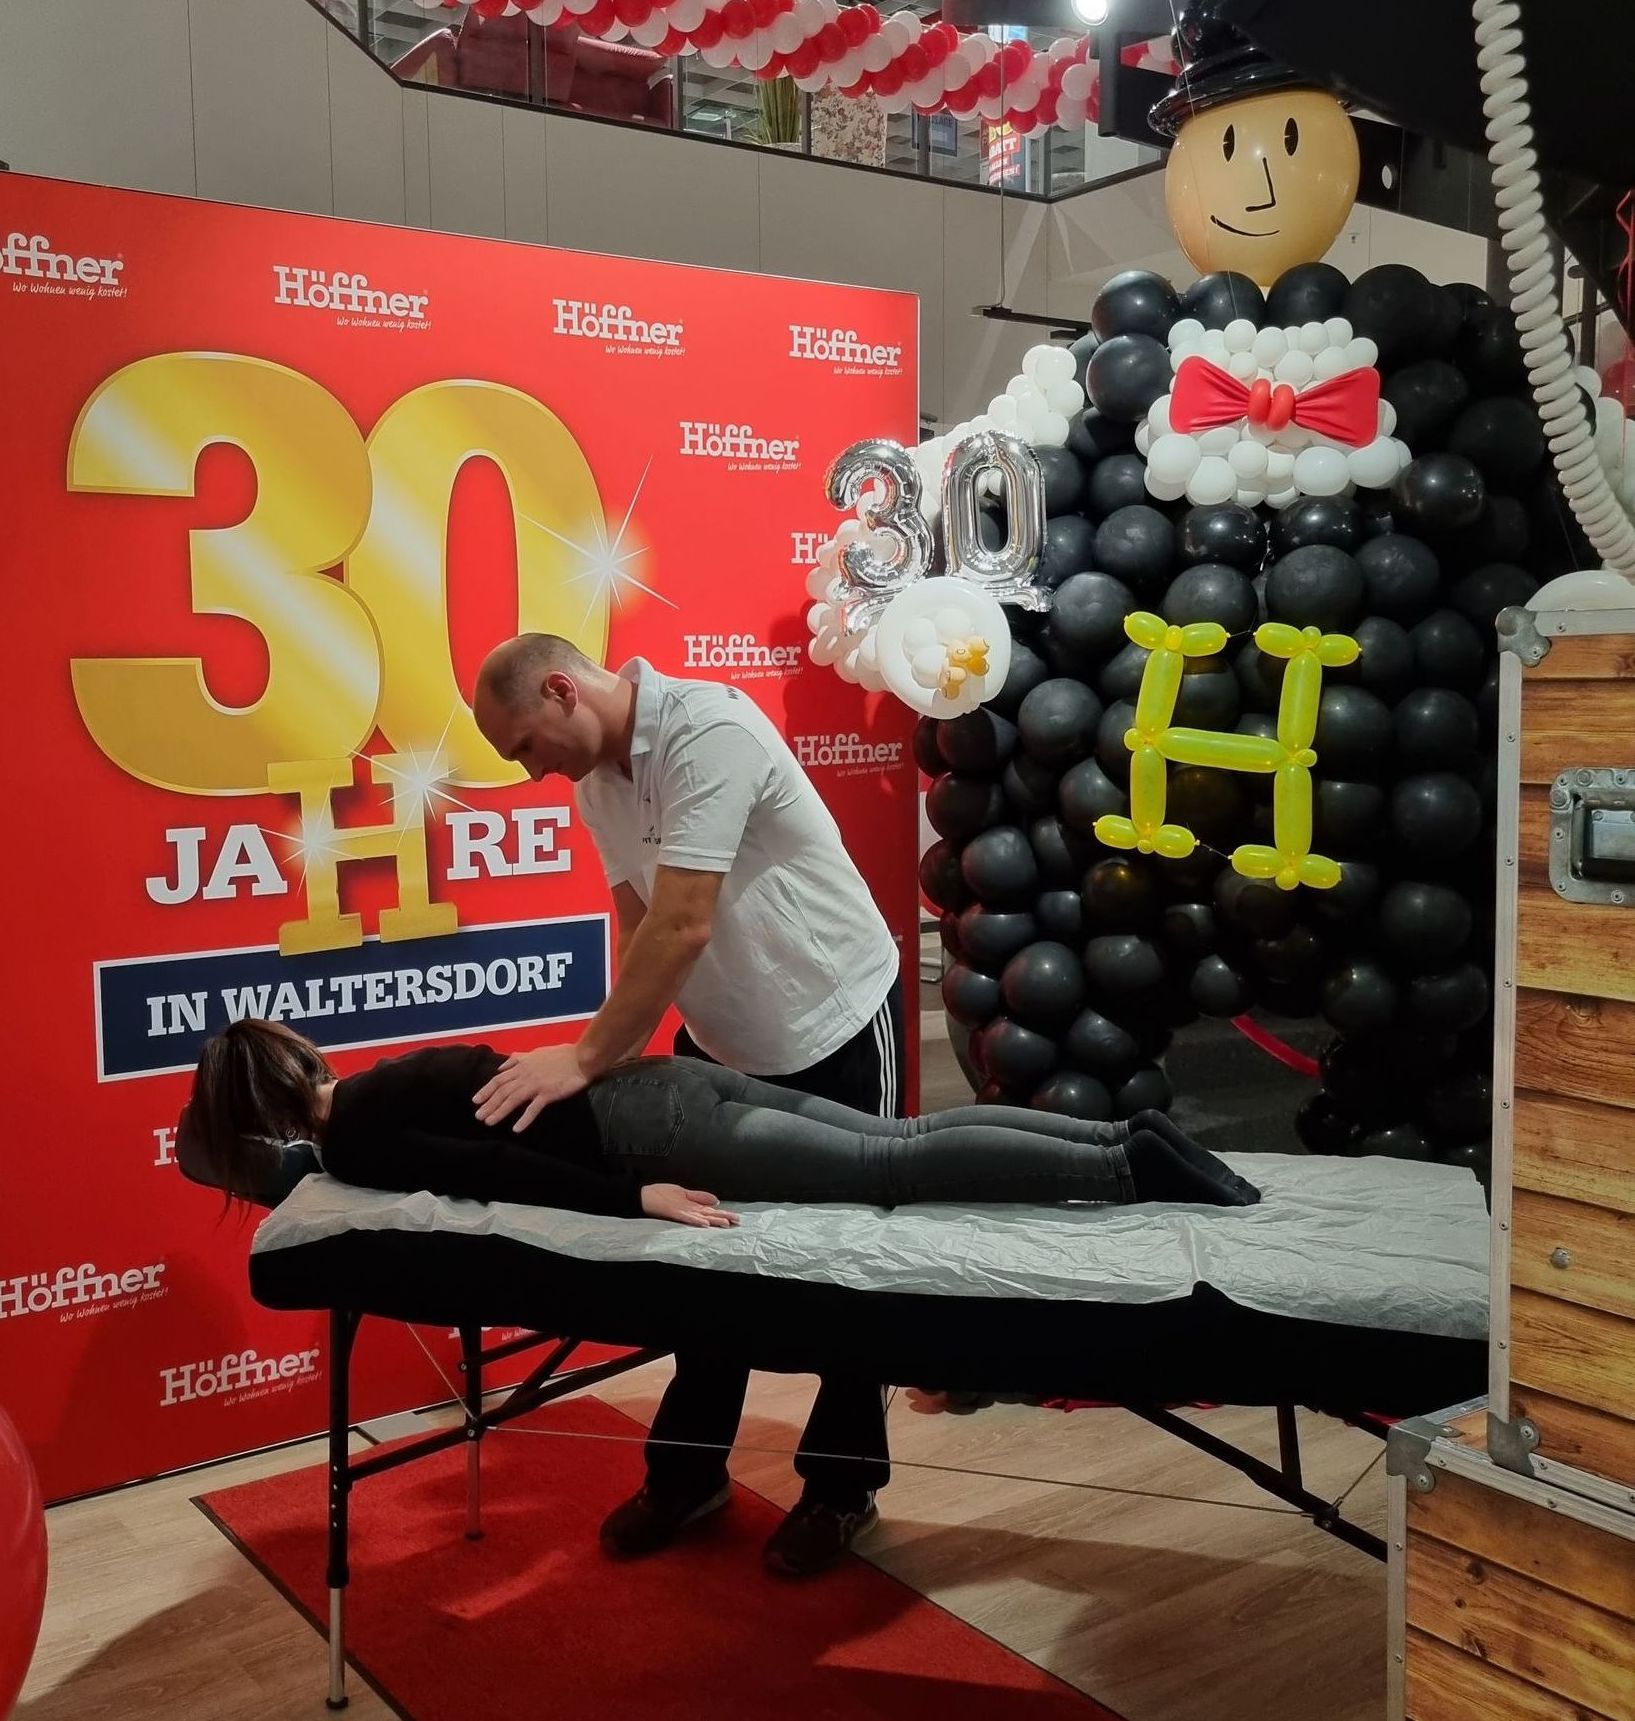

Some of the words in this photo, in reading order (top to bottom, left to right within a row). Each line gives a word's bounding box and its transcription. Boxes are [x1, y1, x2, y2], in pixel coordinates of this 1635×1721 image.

[0, 233, 124, 285] ffner
[12, 282, 27, 292] Wo
[30, 282, 66, 294] Wohnen
[69, 286, 95, 301] wenig
[97, 288, 128, 298] kostet!
[273, 265, 429, 319] Höffner
[552, 299, 683, 346] Höffner
[789, 325, 902, 366] Höffner
[679, 421, 800, 461] Höffner
[824, 430, 1047, 592] 30
[67, 351, 611, 796] 30
[683, 634, 801, 667] Höffner
[793, 733, 903, 766] Höffner
[146, 991, 208, 1037] IN
[221, 952, 573, 1025] WALTERSDORF
[0, 1263, 165, 1319] Höffner
[60, 1313, 74, 1323] Wo
[76, 1304, 110, 1319] Wohnen
[113, 1296, 138, 1309] wenig
[160, 1349, 320, 1407] Höffner
